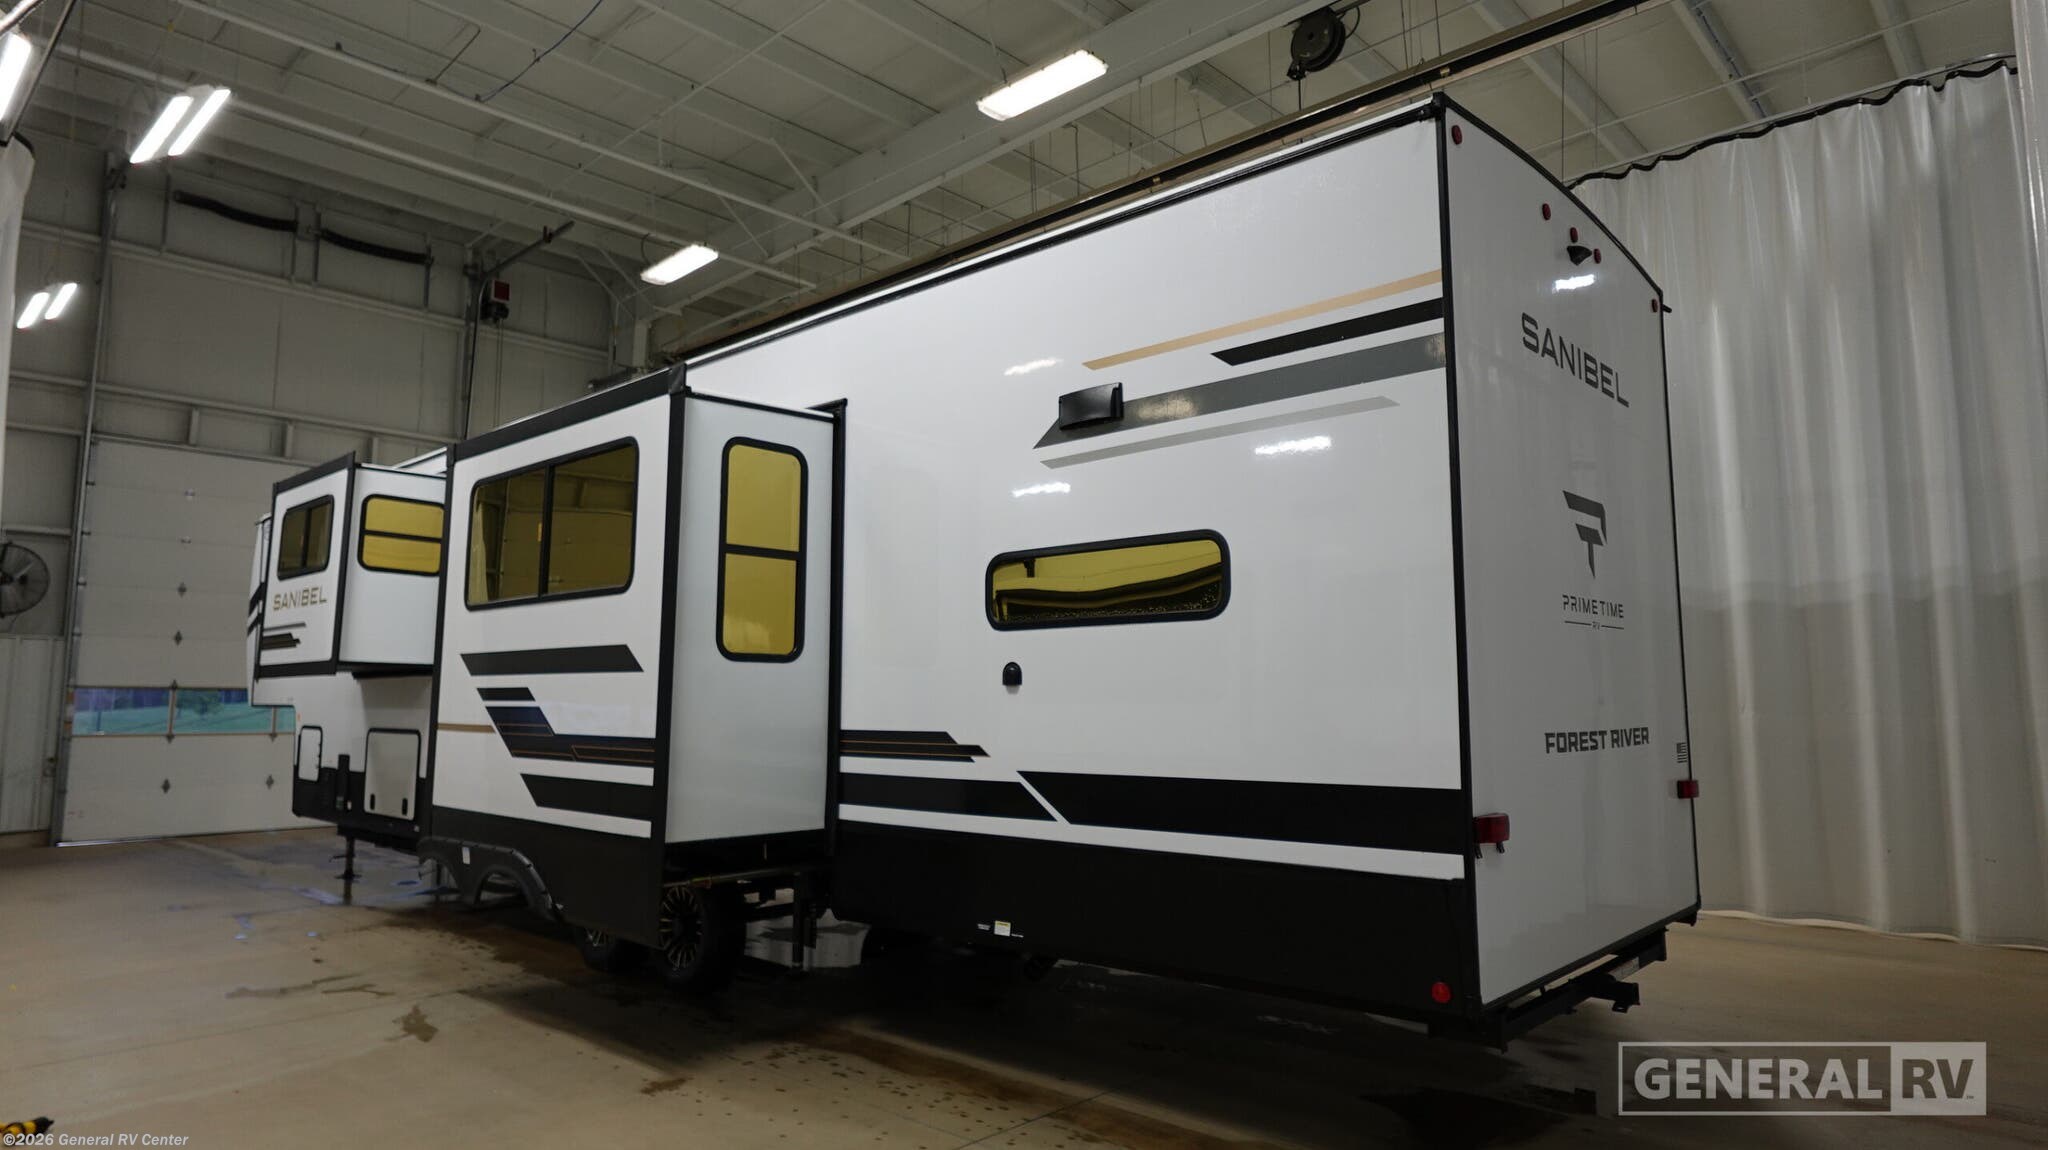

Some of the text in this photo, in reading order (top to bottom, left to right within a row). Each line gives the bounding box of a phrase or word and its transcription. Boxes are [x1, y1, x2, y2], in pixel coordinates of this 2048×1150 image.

[1521, 312, 1629, 408] SANIBEL
[273, 586, 327, 611] SANIBEL
[1544, 727, 1649, 754] FOREST RIVER
